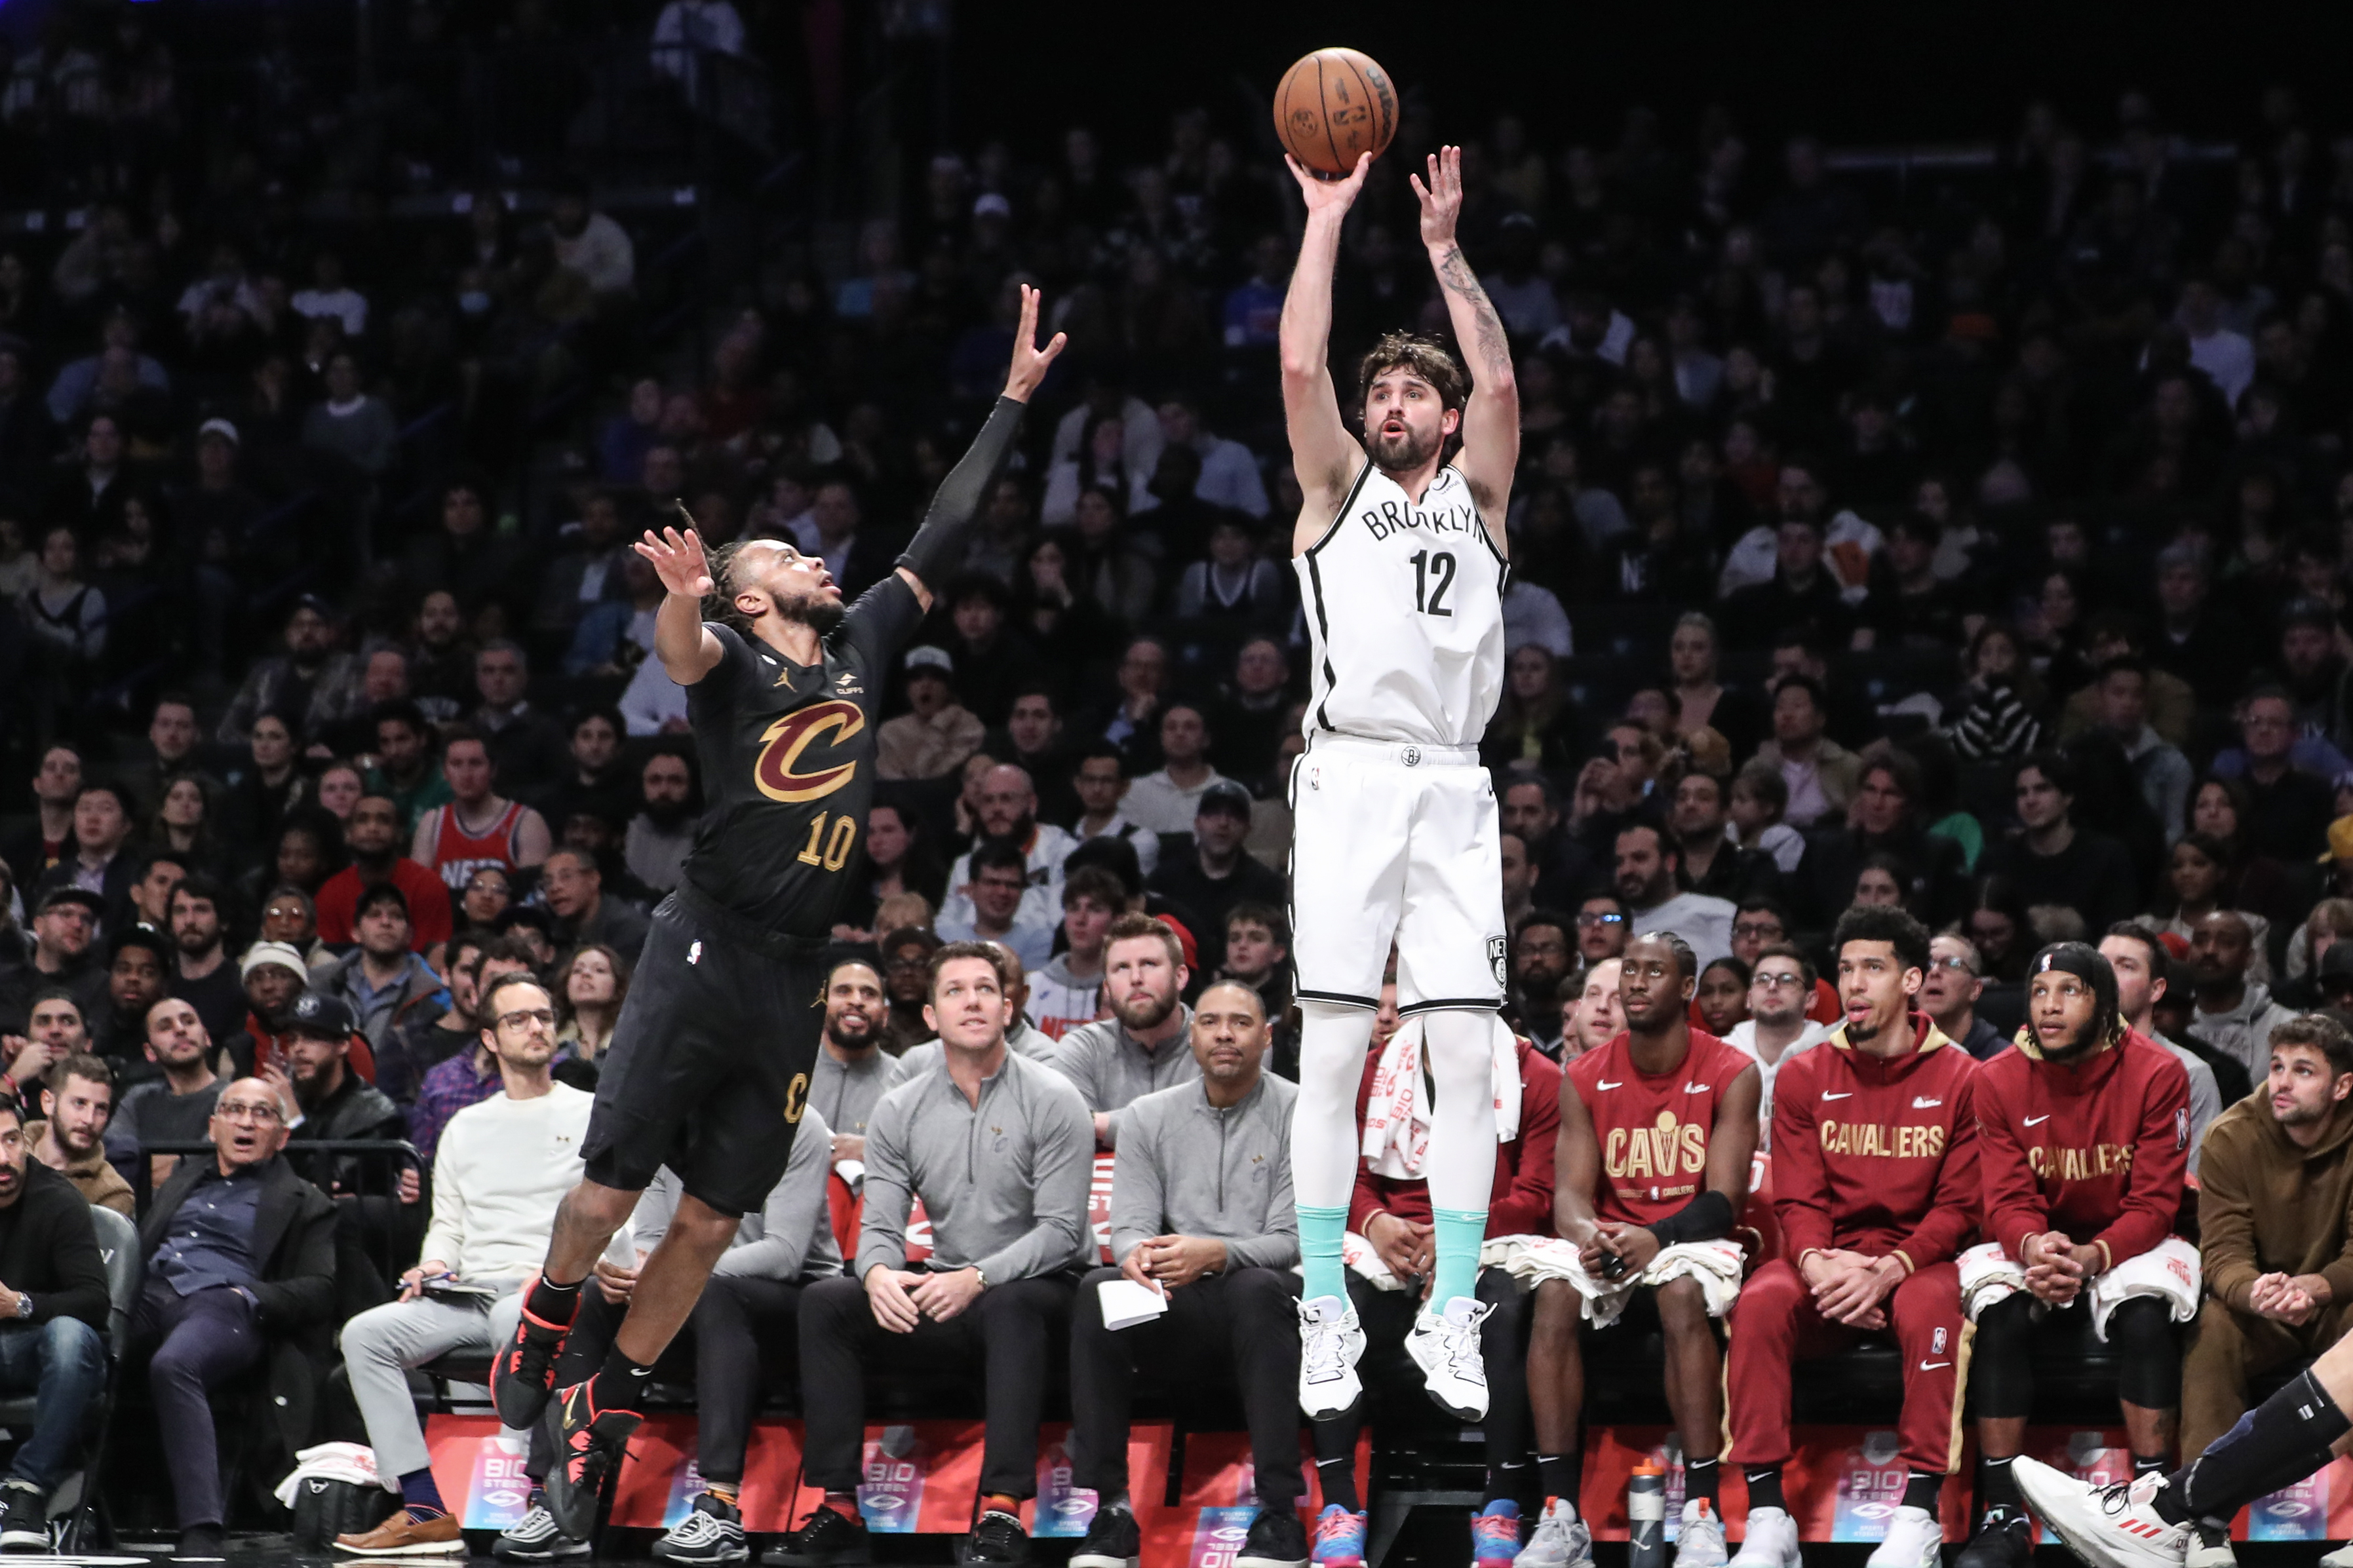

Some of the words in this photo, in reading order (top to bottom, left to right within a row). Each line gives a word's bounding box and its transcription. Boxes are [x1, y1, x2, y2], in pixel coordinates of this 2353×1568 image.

[1410, 549, 1456, 617] 12
[754, 699, 865, 803] C
[797, 811, 857, 871] 10
[783, 1073, 807, 1124] C
[1606, 1120, 1705, 1178] CAVS
[1821, 1120, 1945, 1158] CAVALIERS
[2028, 1143, 2135, 1180] CAVALIERS
[483, 1479, 528, 1488] STEEL
[866, 1483, 909, 1492] STEEL
[868, 1463, 916, 1482] BIO
[1852, 1471, 1903, 1489] BIO
[1851, 1491, 1898, 1500] STEEL
